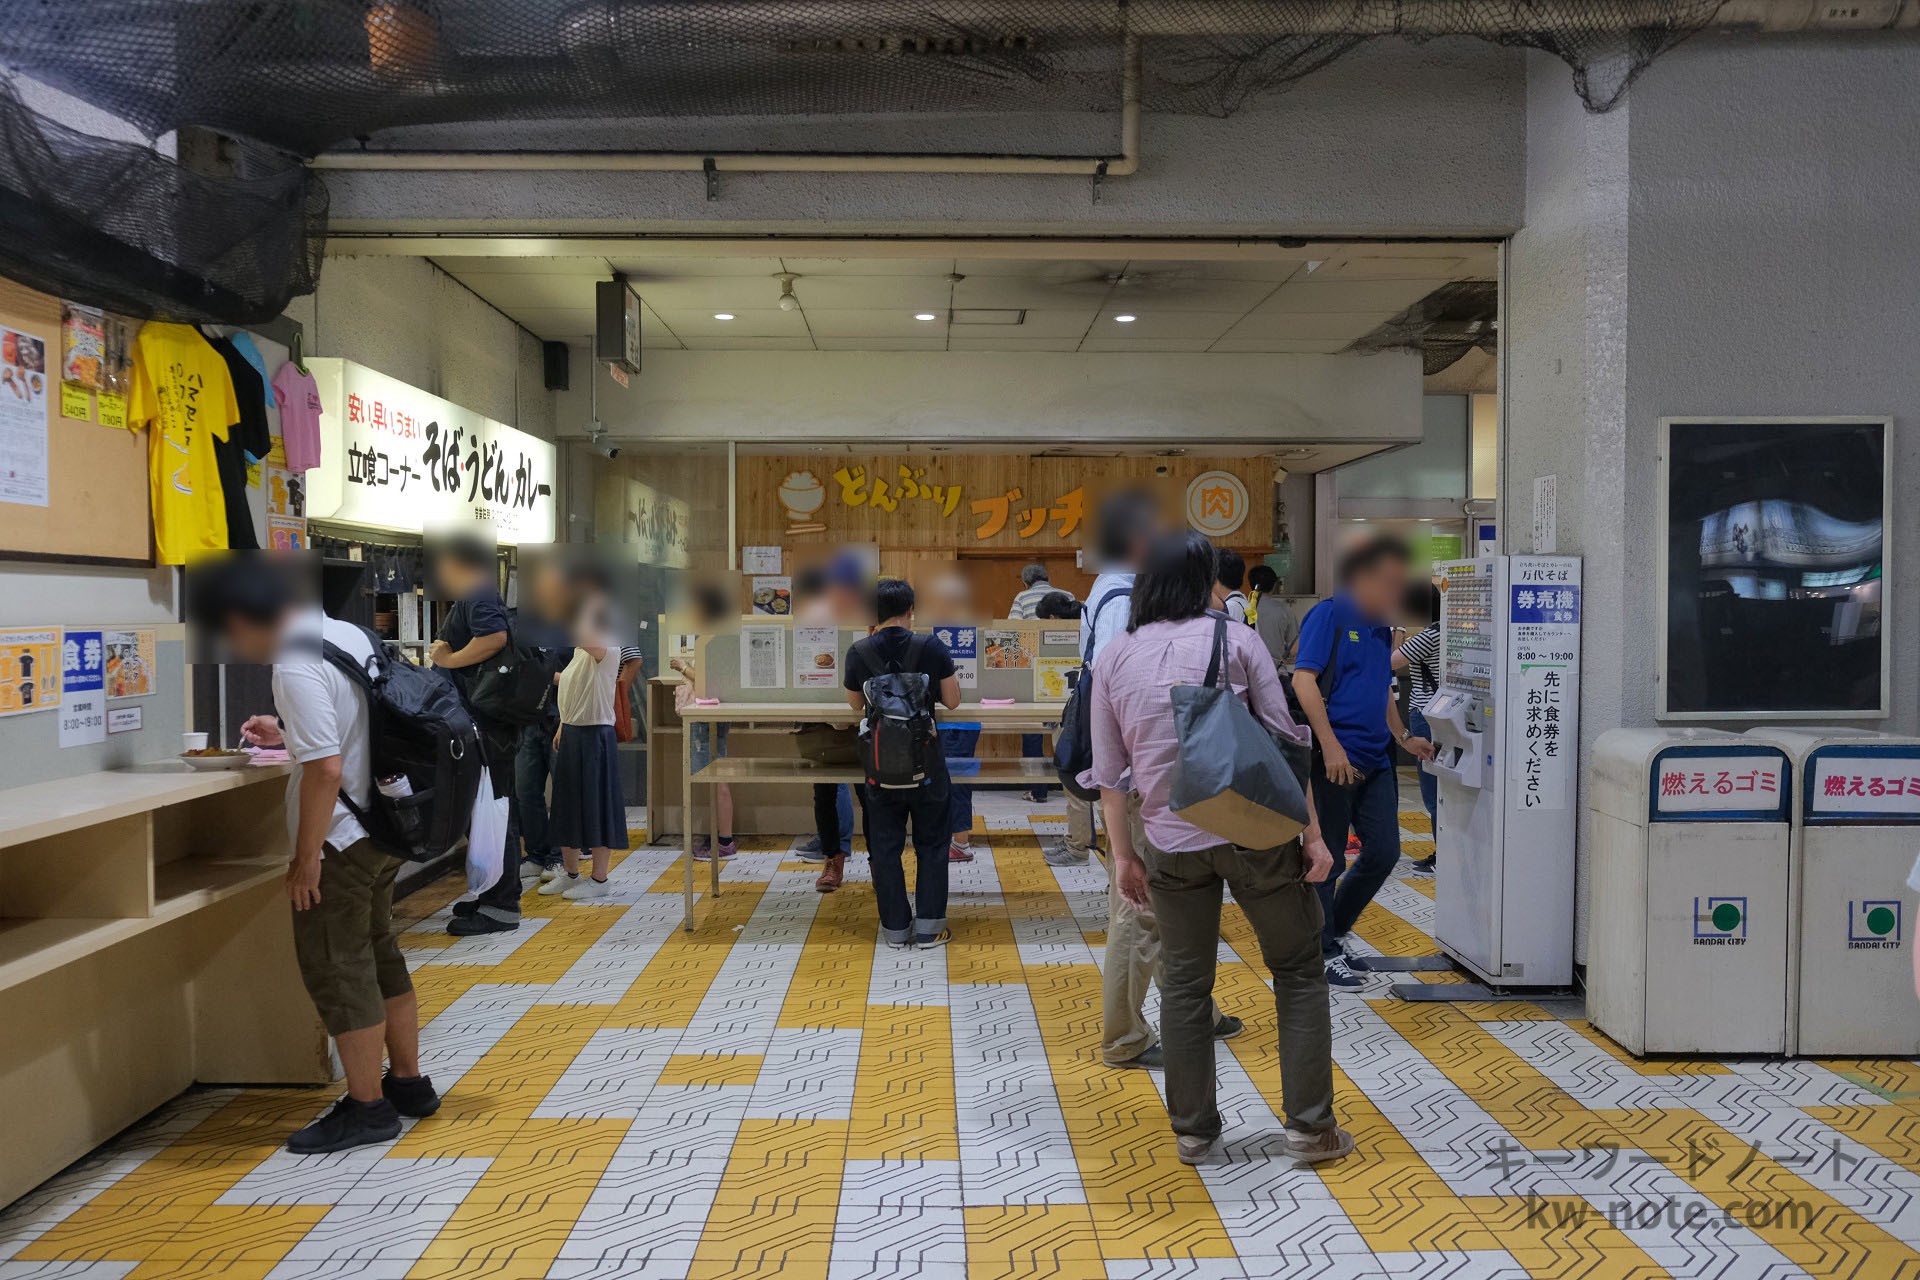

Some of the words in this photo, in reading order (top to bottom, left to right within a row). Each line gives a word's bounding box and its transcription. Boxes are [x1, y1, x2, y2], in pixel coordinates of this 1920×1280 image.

[833, 464, 962, 518] どんぶり
[1201, 485, 1234, 519] 肉
[1522, 570, 1568, 580] 万代そば
[1517, 591, 1574, 609] 券売機
[1554, 611, 1573, 621] 食券
[936, 629, 974, 647] 食券
[64, 639, 101, 671] 食券
[1517, 651, 1536, 660] 8:00
[1550, 652, 1574, 660] 19:00
[1544, 671, 1560, 757] 先に食券を
[1526, 689, 1542, 808] お求めください
[1662, 770, 1777, 796] 燃えるゴミ
[1824, 775, 1920, 797] 燃えるゴミ
